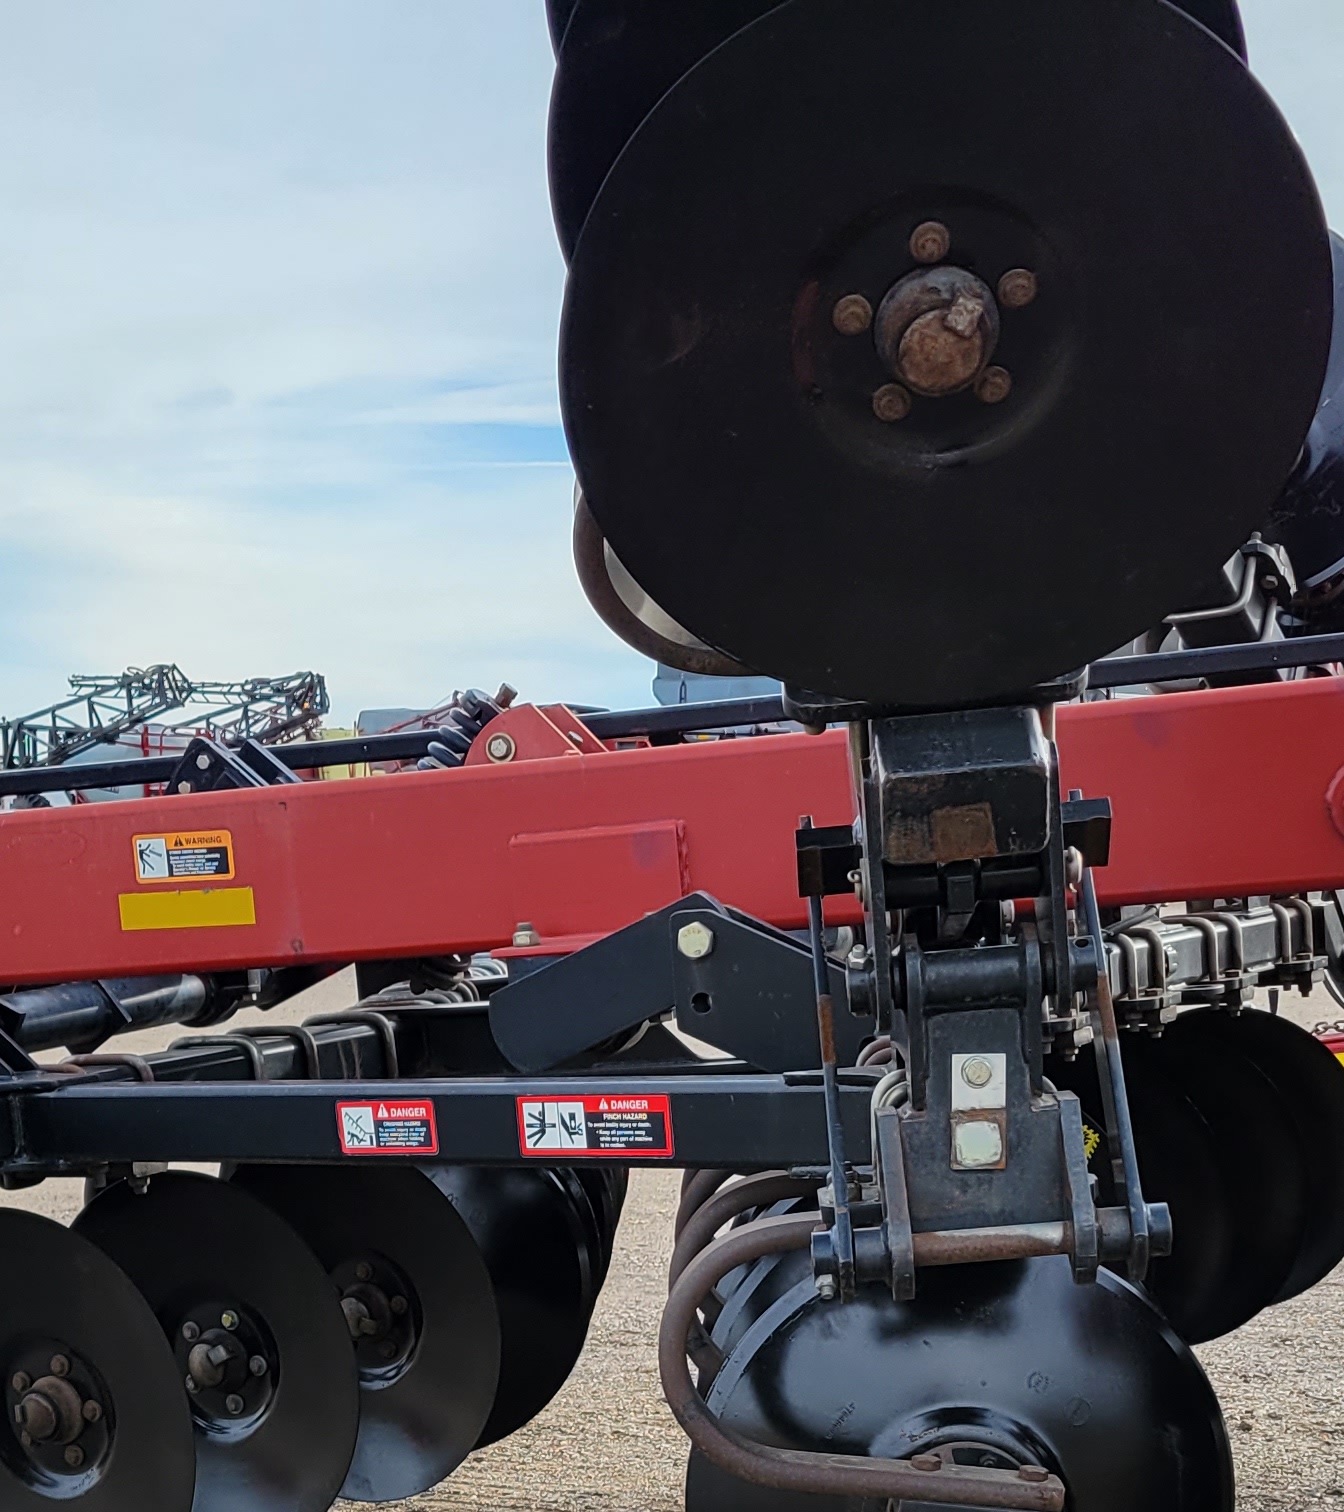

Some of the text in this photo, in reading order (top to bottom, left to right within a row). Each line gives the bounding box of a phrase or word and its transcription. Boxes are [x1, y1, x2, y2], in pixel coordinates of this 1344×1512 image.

[185, 836, 222, 845] WARNING
[611, 1100, 648, 1110] DANGER
[390, 1107, 426, 1117] DANGER
